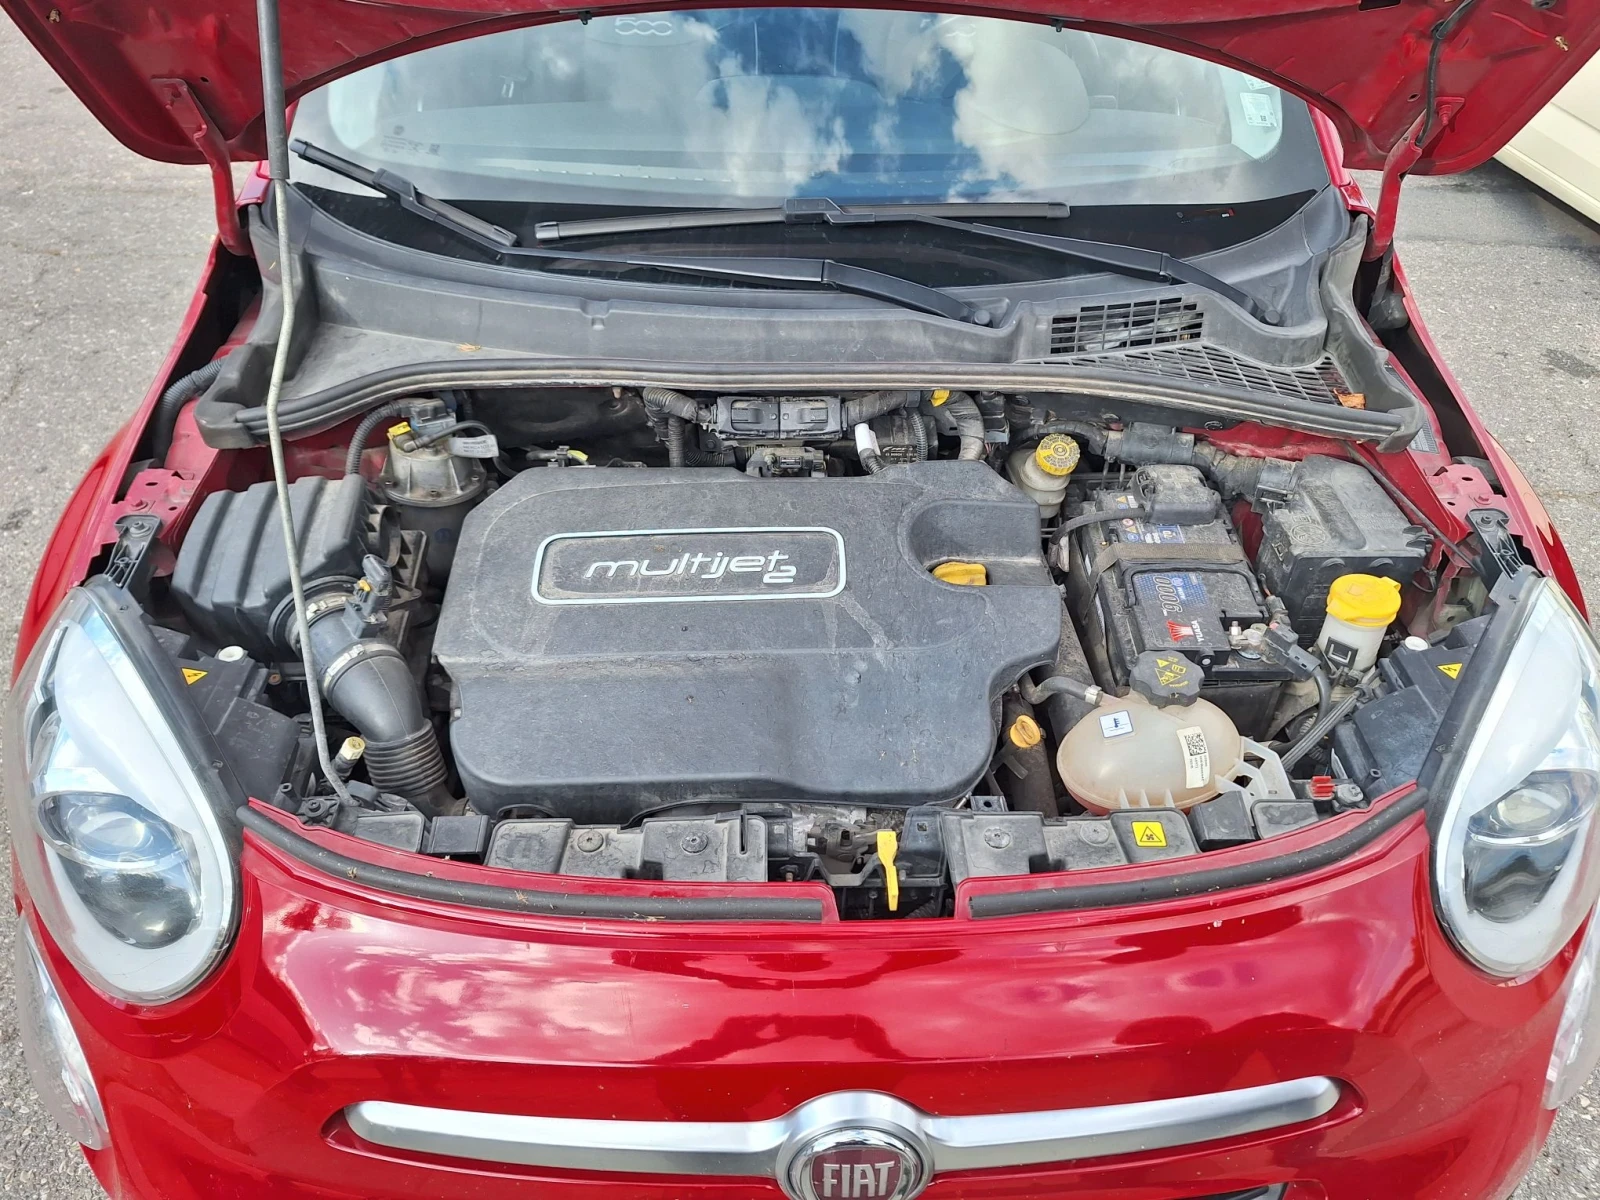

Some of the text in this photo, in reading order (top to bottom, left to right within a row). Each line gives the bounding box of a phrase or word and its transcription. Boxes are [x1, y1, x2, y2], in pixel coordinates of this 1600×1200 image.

[614, 16, 673, 36] 500
[1152, 575, 1183, 613] 9000
[1191, 619, 1205, 642] YUASA
[823, 1160, 895, 1198] FIAT
